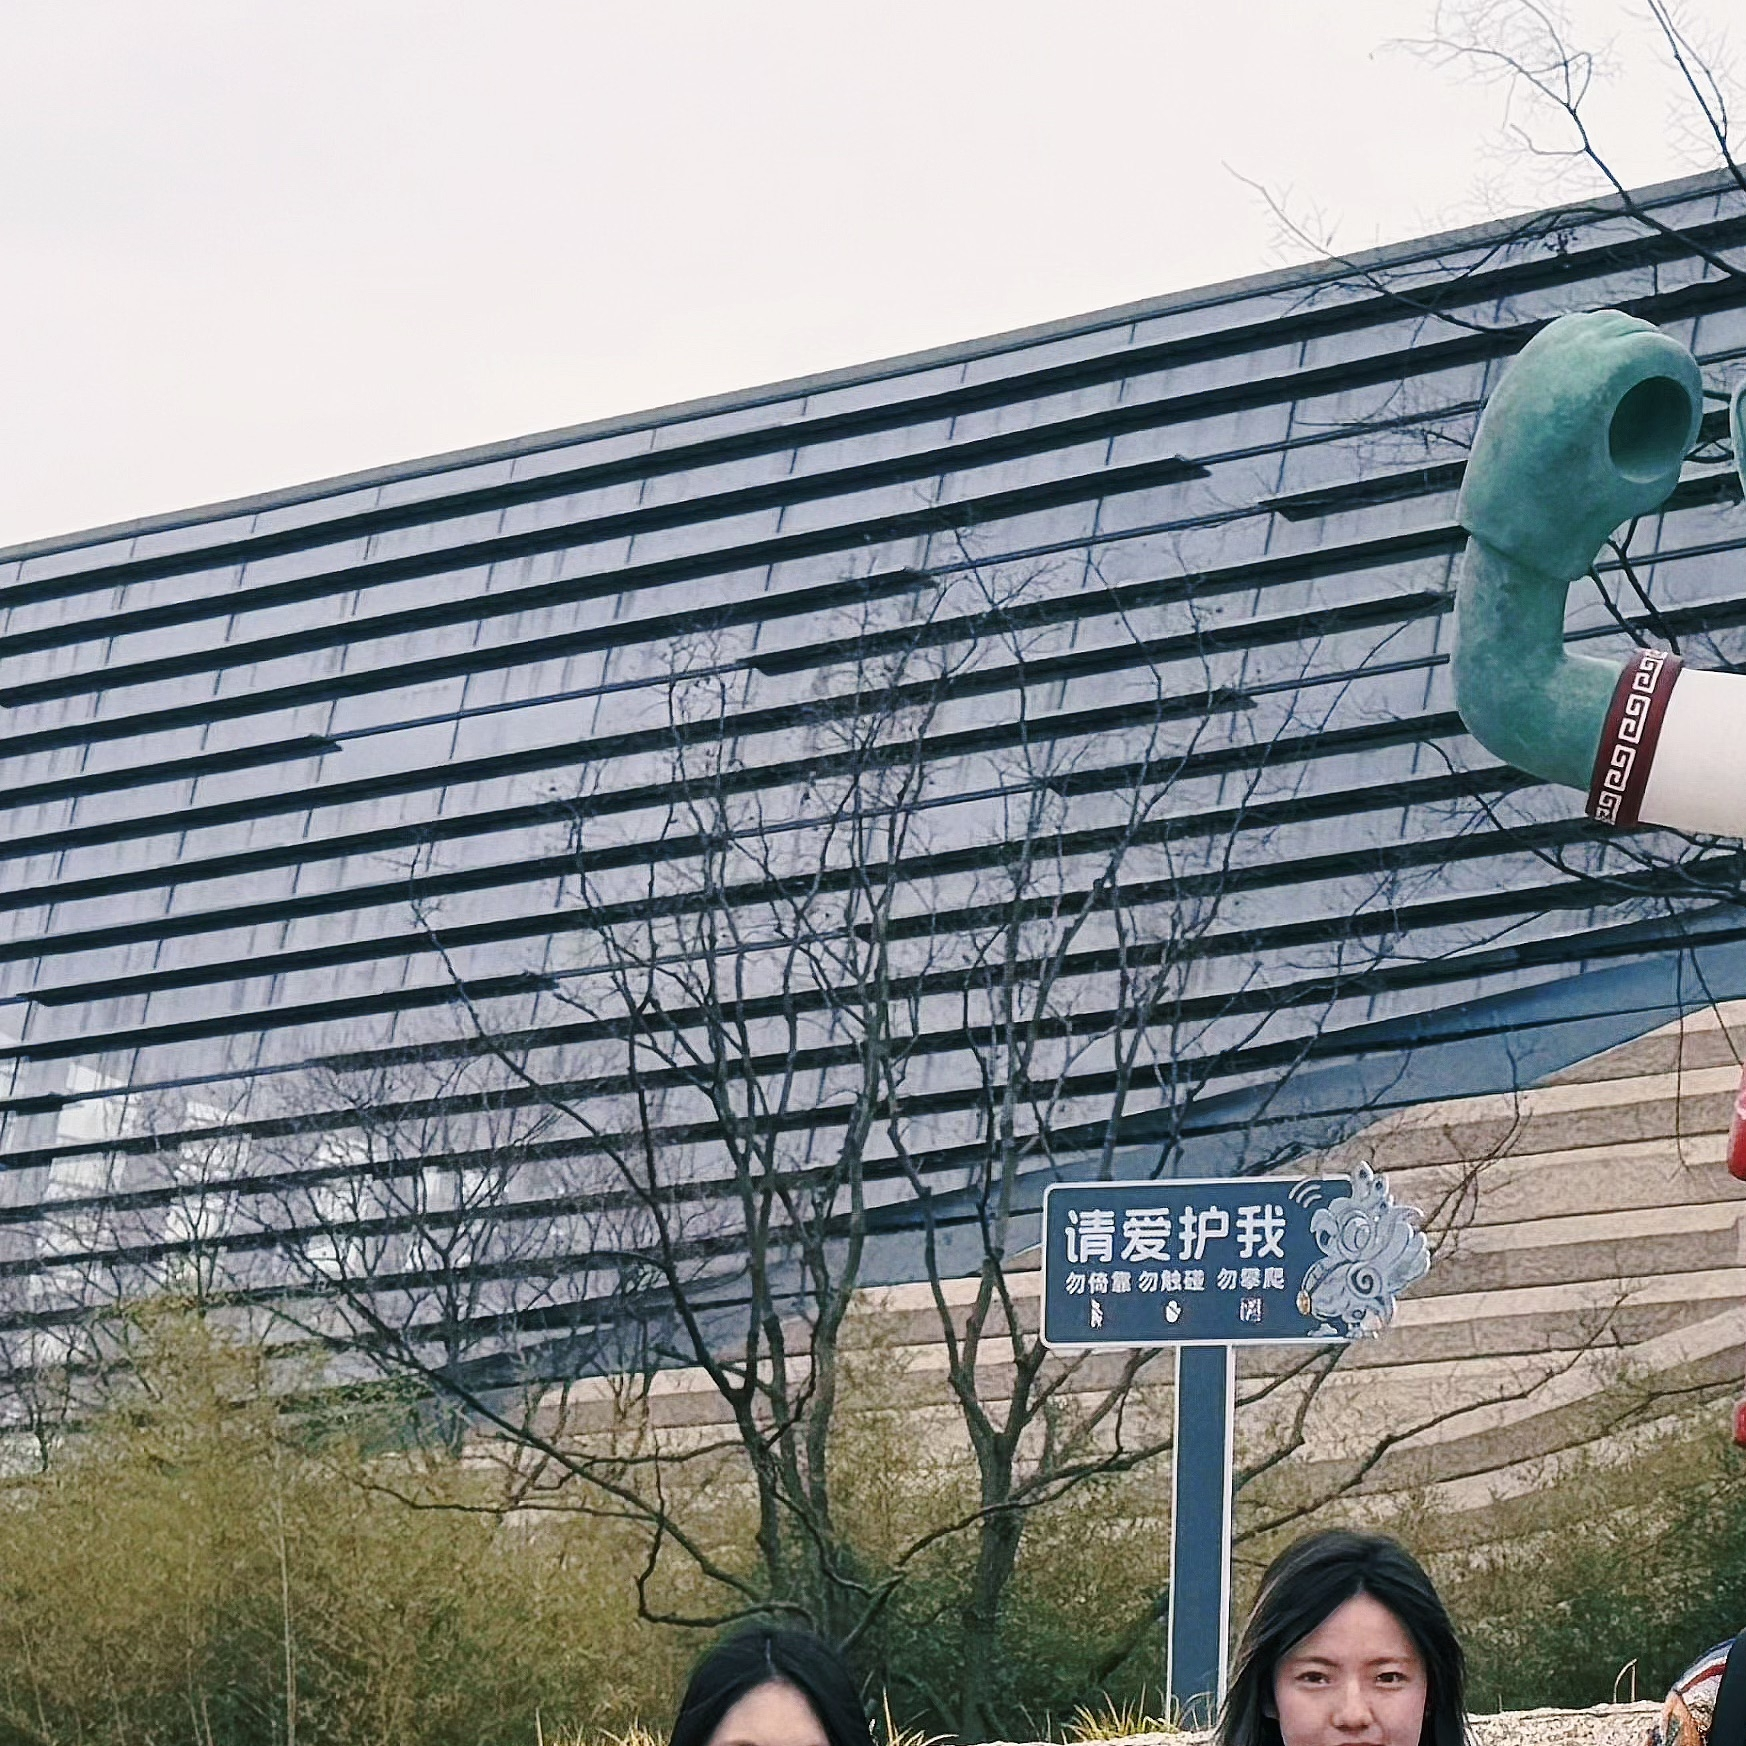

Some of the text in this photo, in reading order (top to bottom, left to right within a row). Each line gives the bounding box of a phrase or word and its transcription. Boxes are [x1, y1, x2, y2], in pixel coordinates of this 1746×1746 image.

[1065, 1204, 1286, 1263] 请爱护我
[1065, 1267, 1286, 1295] 勿倚靠 勿触碰 勿攀爬
